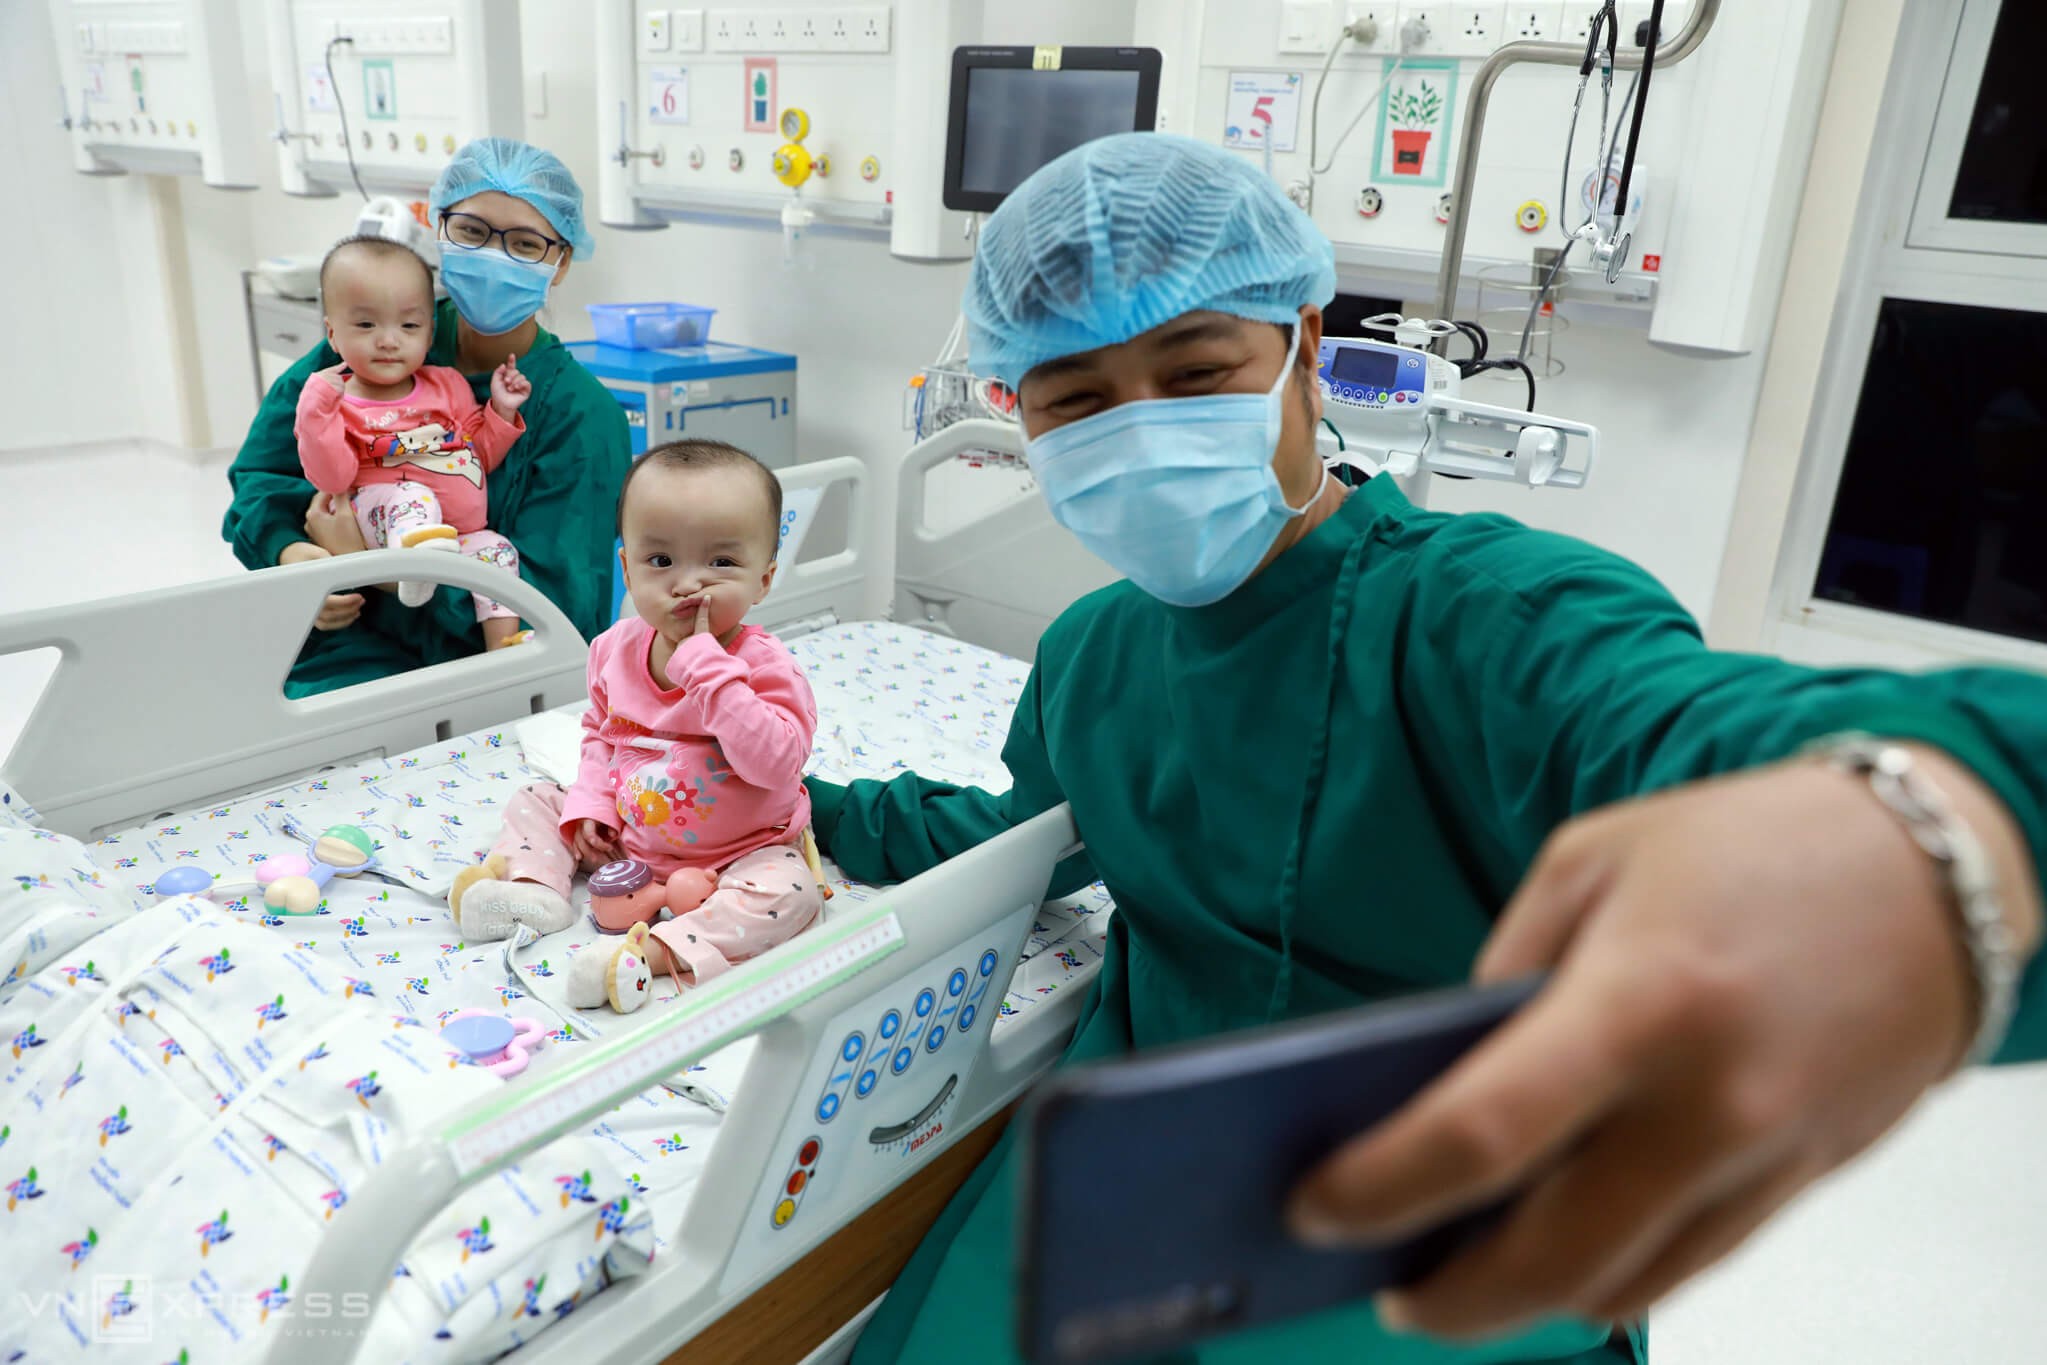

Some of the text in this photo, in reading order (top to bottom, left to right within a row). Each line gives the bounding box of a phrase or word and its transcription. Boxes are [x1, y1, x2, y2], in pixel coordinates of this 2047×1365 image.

[663, 83, 676, 115] 6
[1251, 96, 1275, 138] 5
[510, 901, 545, 919] baby
